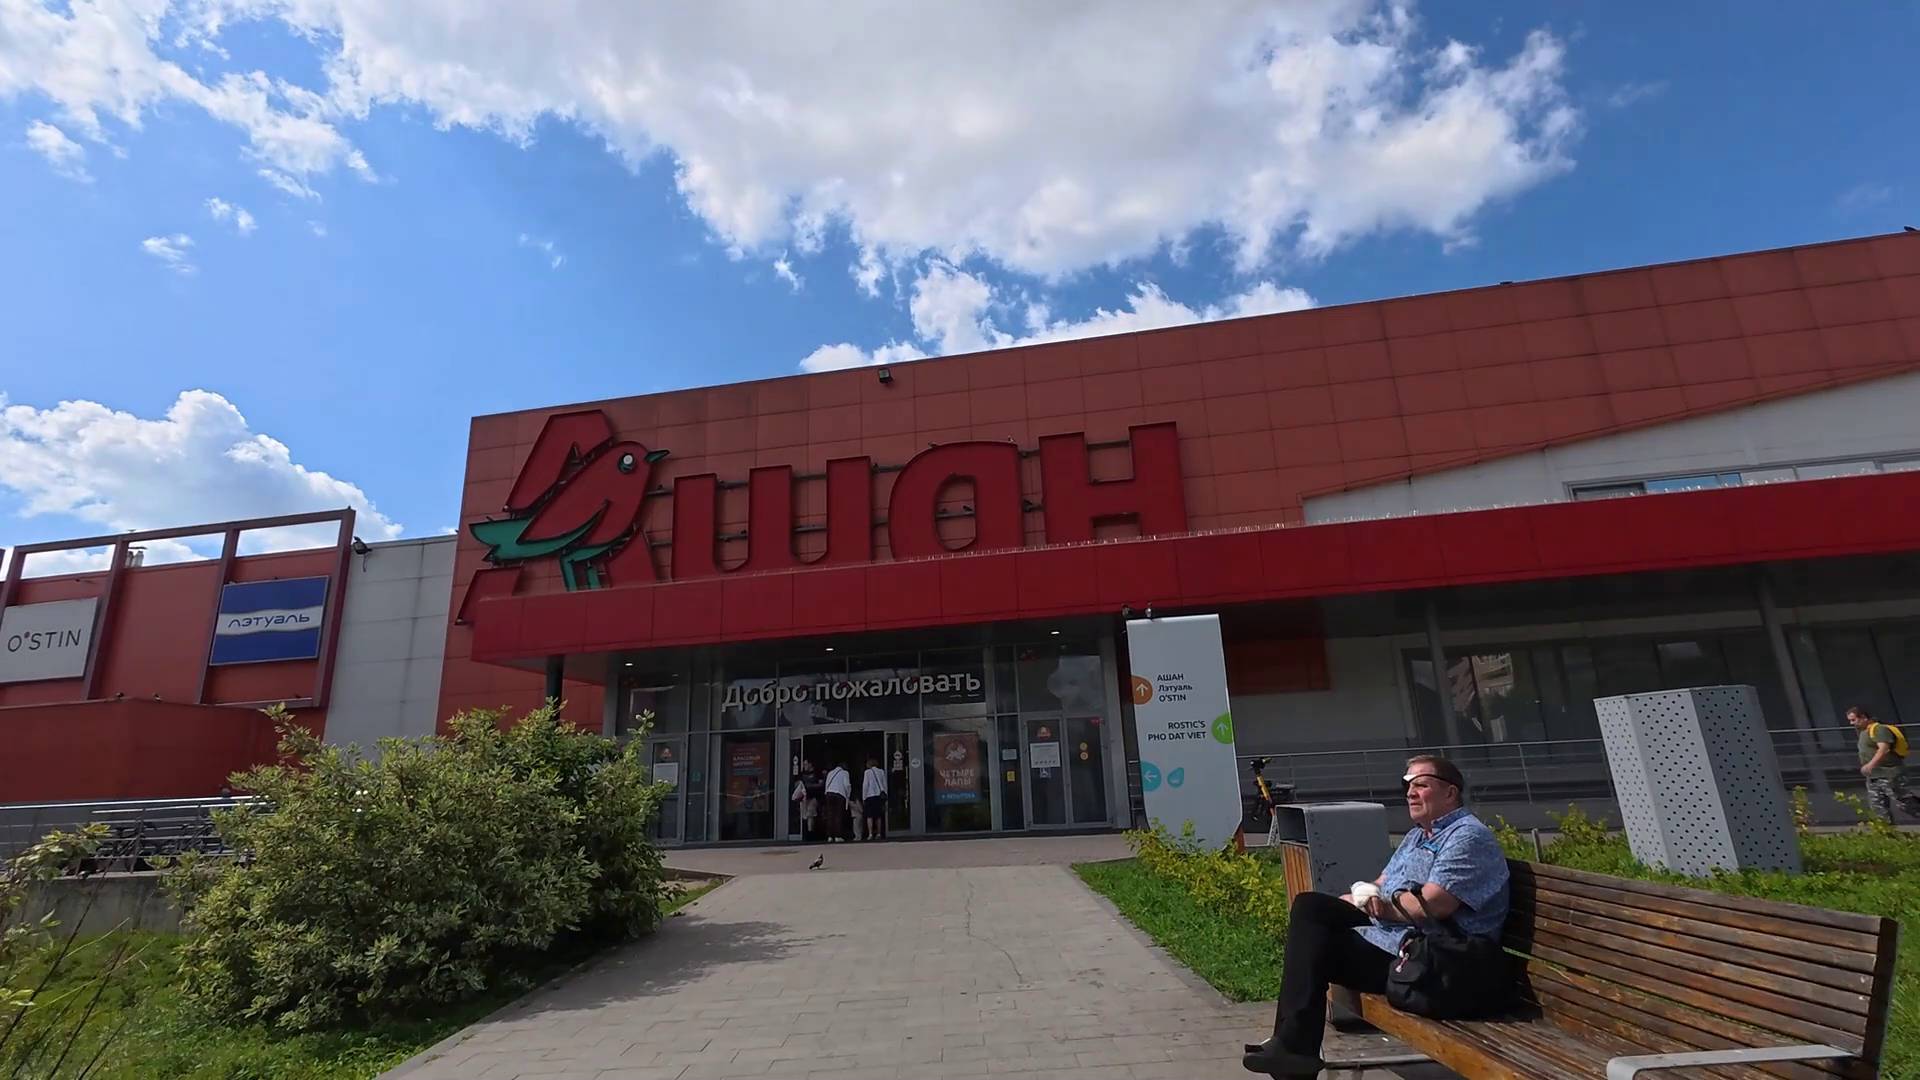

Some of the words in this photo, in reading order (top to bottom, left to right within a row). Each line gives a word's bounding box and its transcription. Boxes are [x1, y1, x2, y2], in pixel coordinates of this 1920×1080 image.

[1157, 673, 1184, 682] АШАН
[721, 680, 808, 712] Добро
[816, 673, 981, 700] пожаловать
[1158, 684, 1193, 693] Лэтуаль
[1159, 694, 1187, 703] O'STIN
[1168, 720, 1206, 730] ROSTIC'S
[1148, 733, 1166, 741] PHO
[1168, 732, 1185, 740] DAT
[1187, 731, 1207, 740] VIET
[939, 768, 975, 778] ЧЕТЫРЕ
[944, 777, 972, 787] ЛАПЫ
